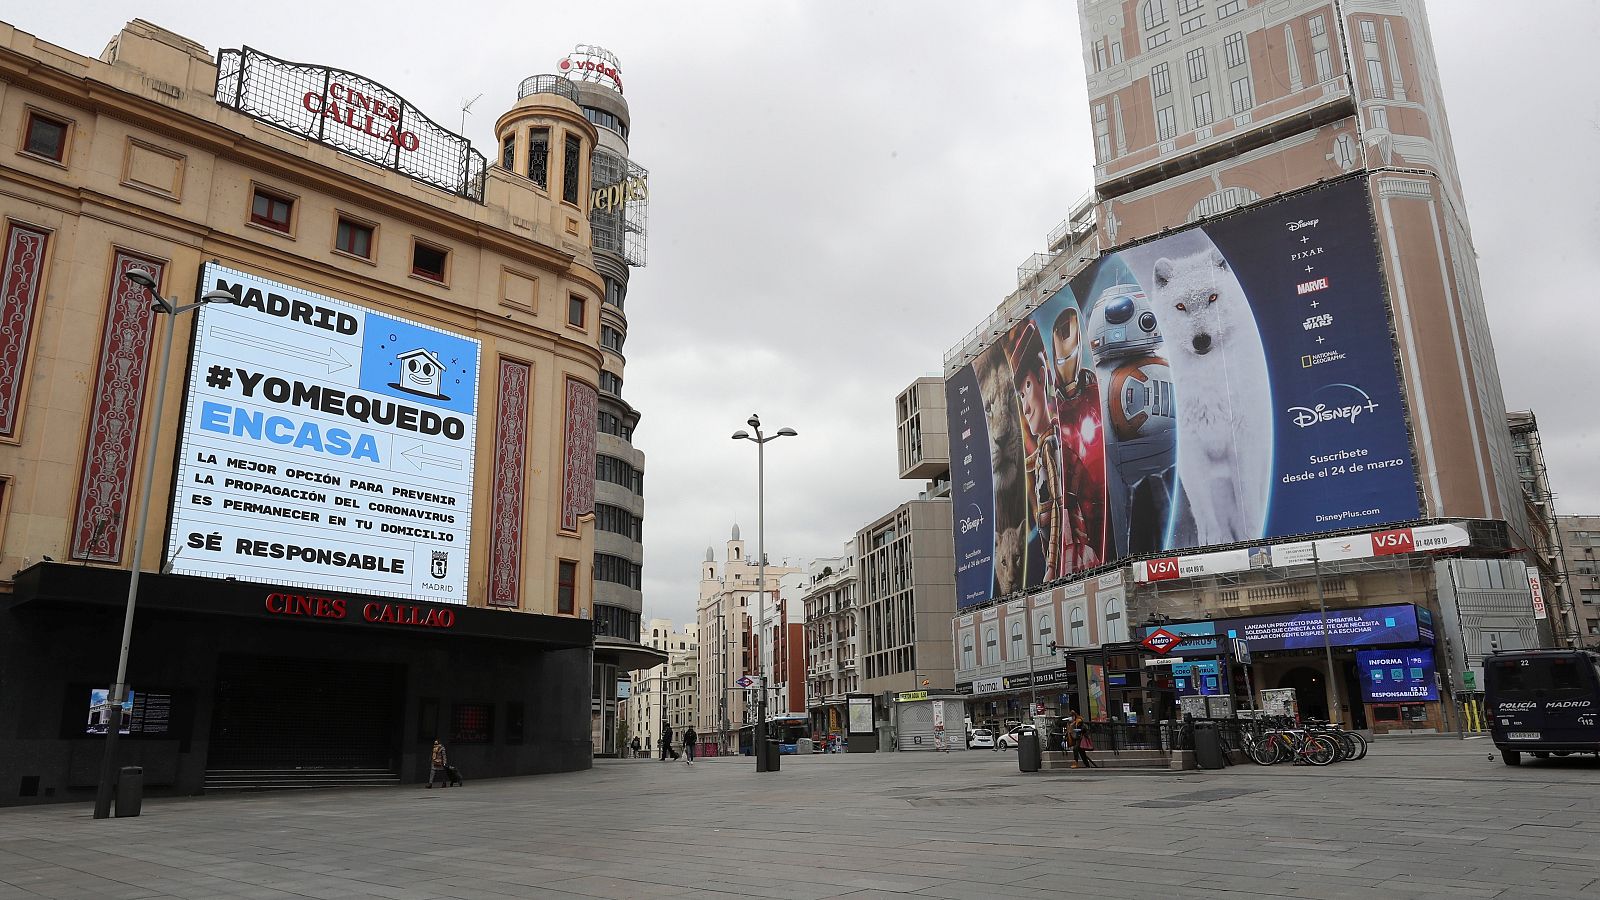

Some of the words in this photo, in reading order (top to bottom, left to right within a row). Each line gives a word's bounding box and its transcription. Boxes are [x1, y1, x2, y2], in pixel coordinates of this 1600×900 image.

[575, 44, 622, 74] CAPITO
[330, 83, 400, 122] CINES
[303, 91, 420, 152] CALLAO
[1286, 219, 1319, 231] Disney
[1291, 247, 1323, 261] PIXAR
[1297, 278, 1328, 294] MARVEL
[216, 278, 358, 336] MADRID
[1305, 314, 1331, 324] STAR
[1303, 319, 1333, 330] WARS
[1313, 350, 1338, 360] NATIONAL
[1313, 353, 1346, 365] GEOGRAPHIC
[206, 364, 465, 441] #YOMEQUEDO
[200, 401, 380, 464] ENCASA
[1310, 448, 1368, 465] Suscríbete
[198, 452, 217, 464] LA
[227, 457, 277, 475] MEJOR
[286, 468, 340, 487] OPCIÓN
[350, 479, 383, 494] PARA
[393, 486, 456, 506] PREVENIR
[1282, 472, 1315, 483] desde
[1318, 468, 1328, 478] el
[1332, 467, 1345, 476] 24
[1350, 463, 1364, 473] de
[1367, 458, 1404, 470] marzo
[195, 473, 214, 485] LA
[225, 478, 326, 504] PROPAGACIÓN
[335, 496, 360, 509] DEL
[369, 502, 455, 524] CORONAVIRUS
[192, 494, 212, 506] ES
[223, 499, 320, 523] PERMANECER
[329, 515, 347, 527] EN
[355, 519, 373, 530] TU
[381, 523, 454, 543] DOMICILIO
[1316, 508, 1380, 522] DisneyPlus.com
[187, 532, 223, 551] SÉ
[236, 538, 405, 575] RESPONSABLE
[422, 582, 453, 593] MADRID
[266, 593, 347, 619] CINES
[364, 602, 455, 628] CALLAO
